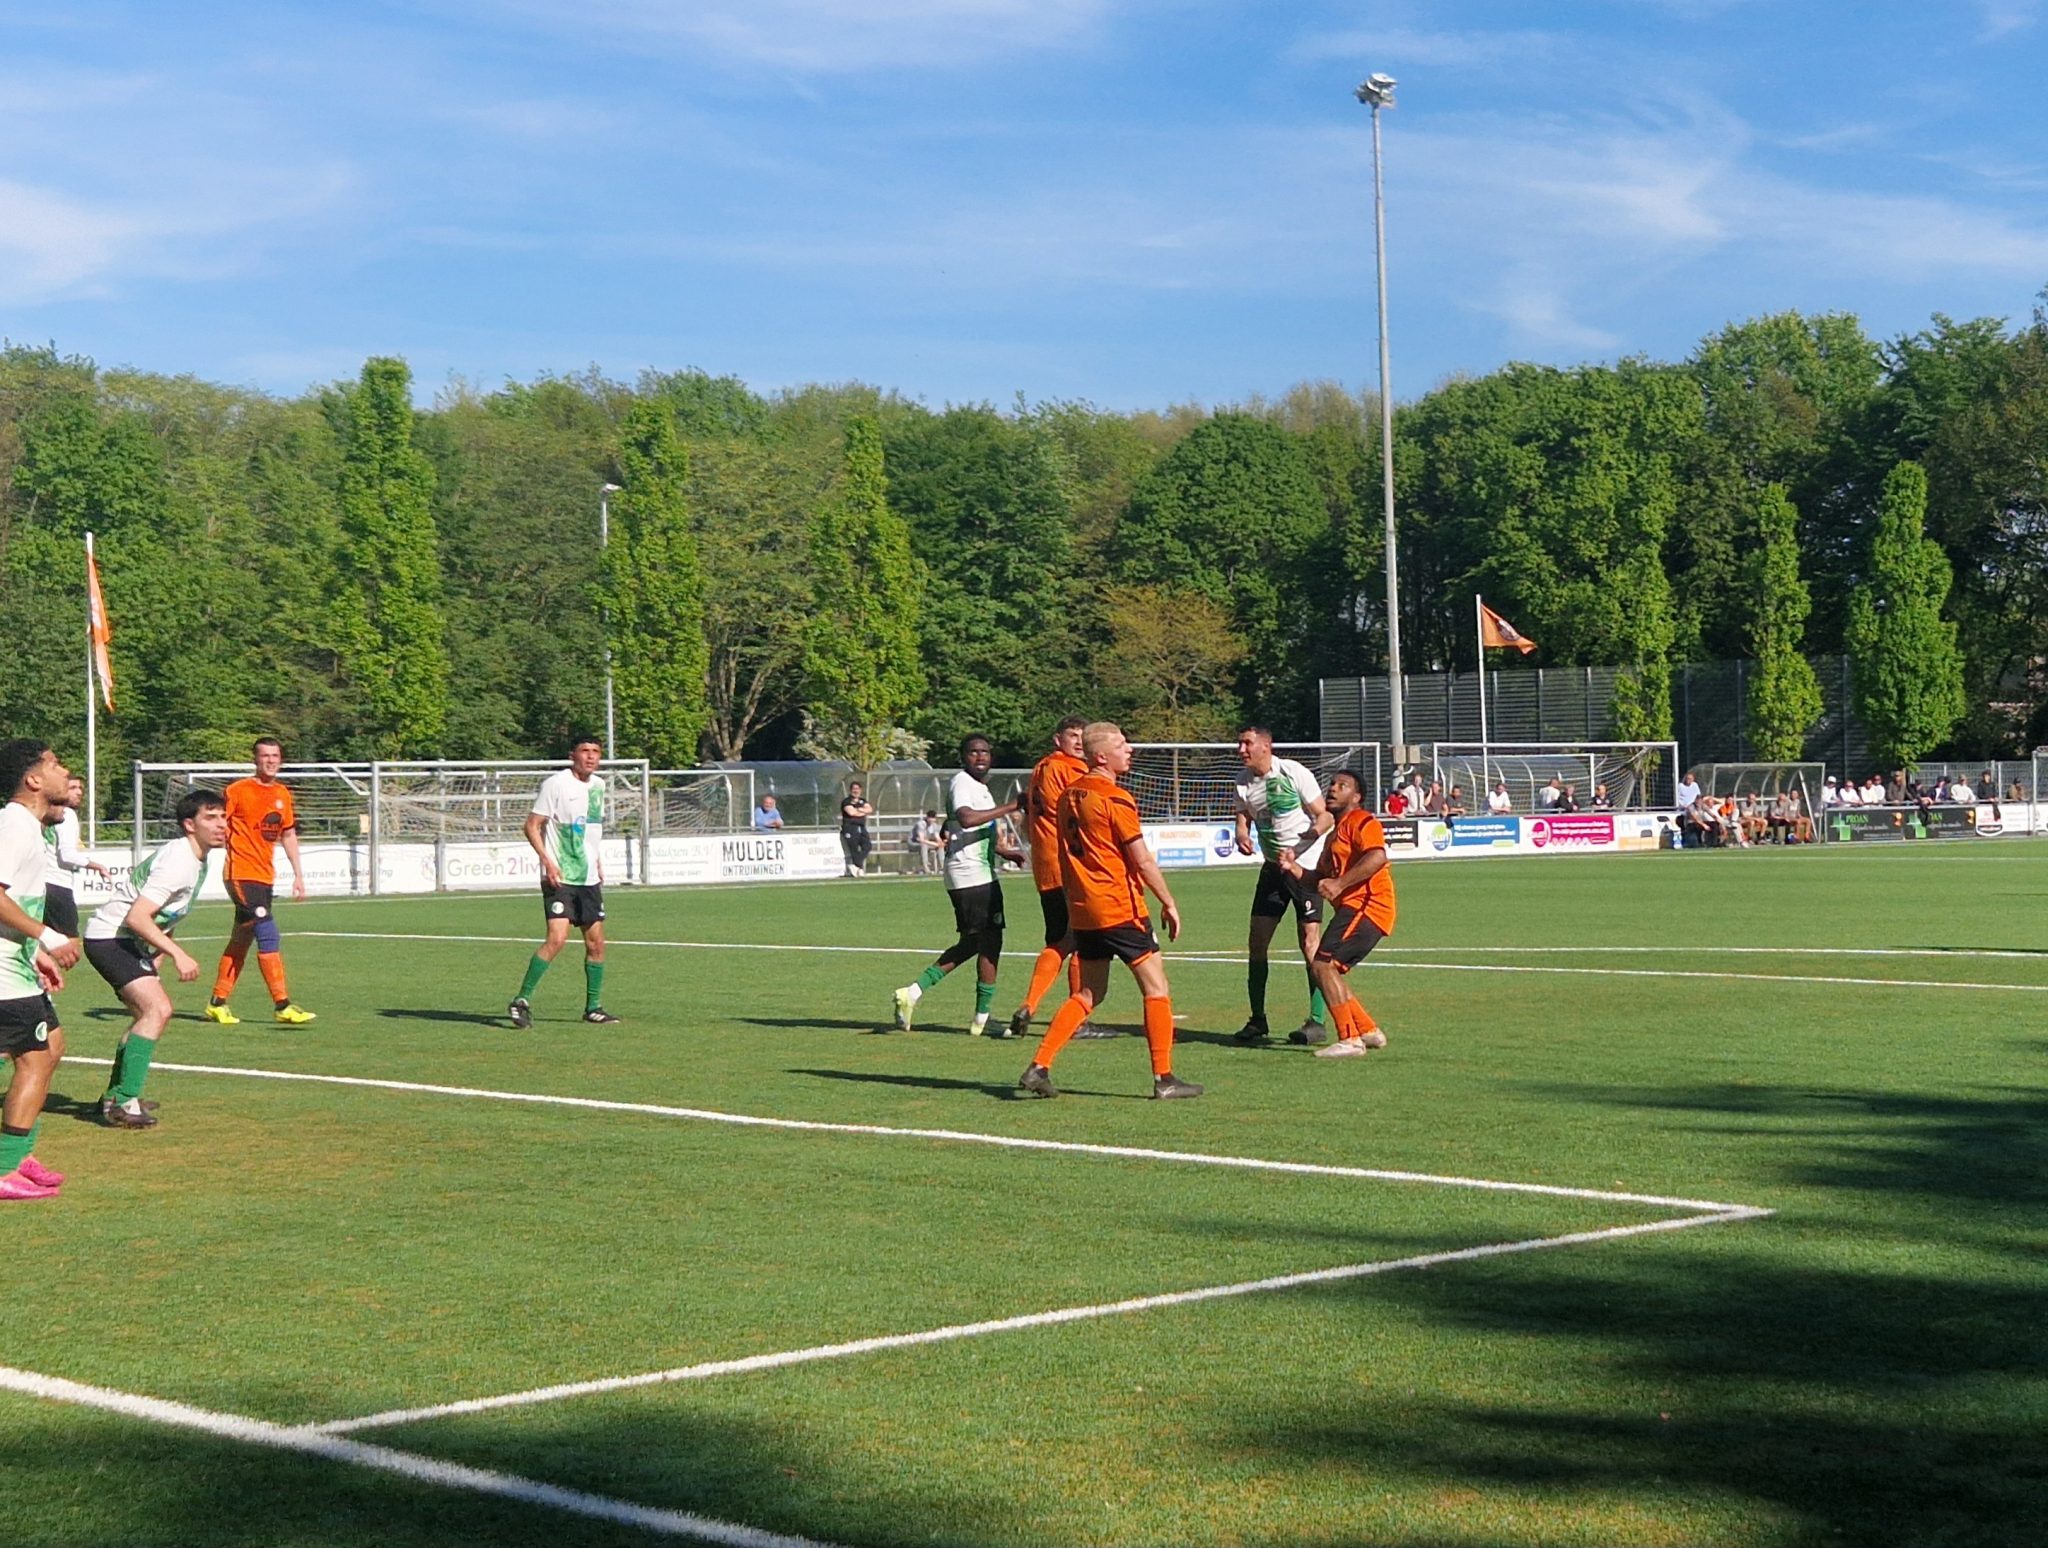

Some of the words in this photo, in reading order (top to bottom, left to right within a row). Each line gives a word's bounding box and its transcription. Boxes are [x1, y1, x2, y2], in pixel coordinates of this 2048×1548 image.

[722, 840, 784, 862] MULDER
[447, 856, 541, 877] Green2liv
[722, 863, 785, 877] ONTRUIMINGEN
[1305, 900, 1312, 911] 9
